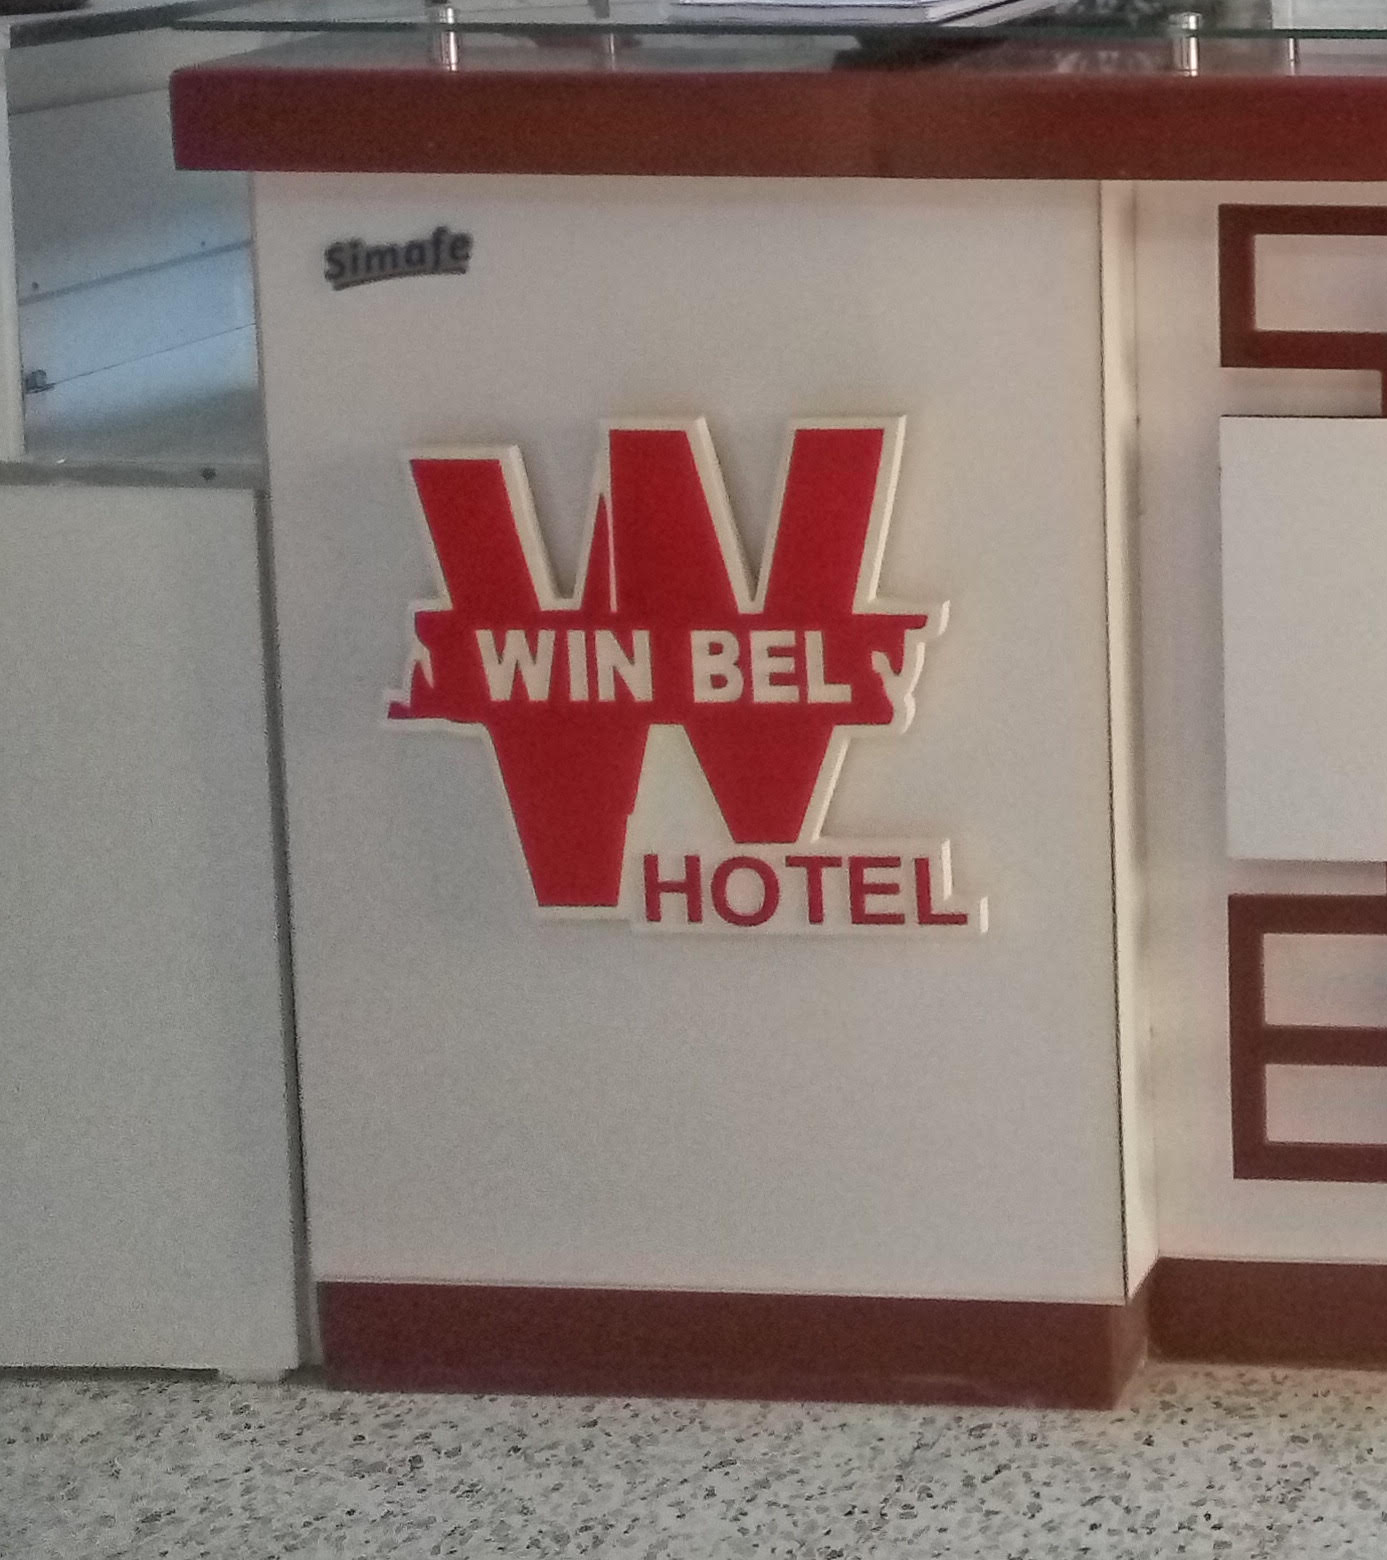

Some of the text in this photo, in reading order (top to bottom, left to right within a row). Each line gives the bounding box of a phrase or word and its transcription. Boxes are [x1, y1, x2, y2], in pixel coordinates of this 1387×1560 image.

[475, 629, 852, 704] WIN BEL
[643, 852, 969, 926] HOTEL
